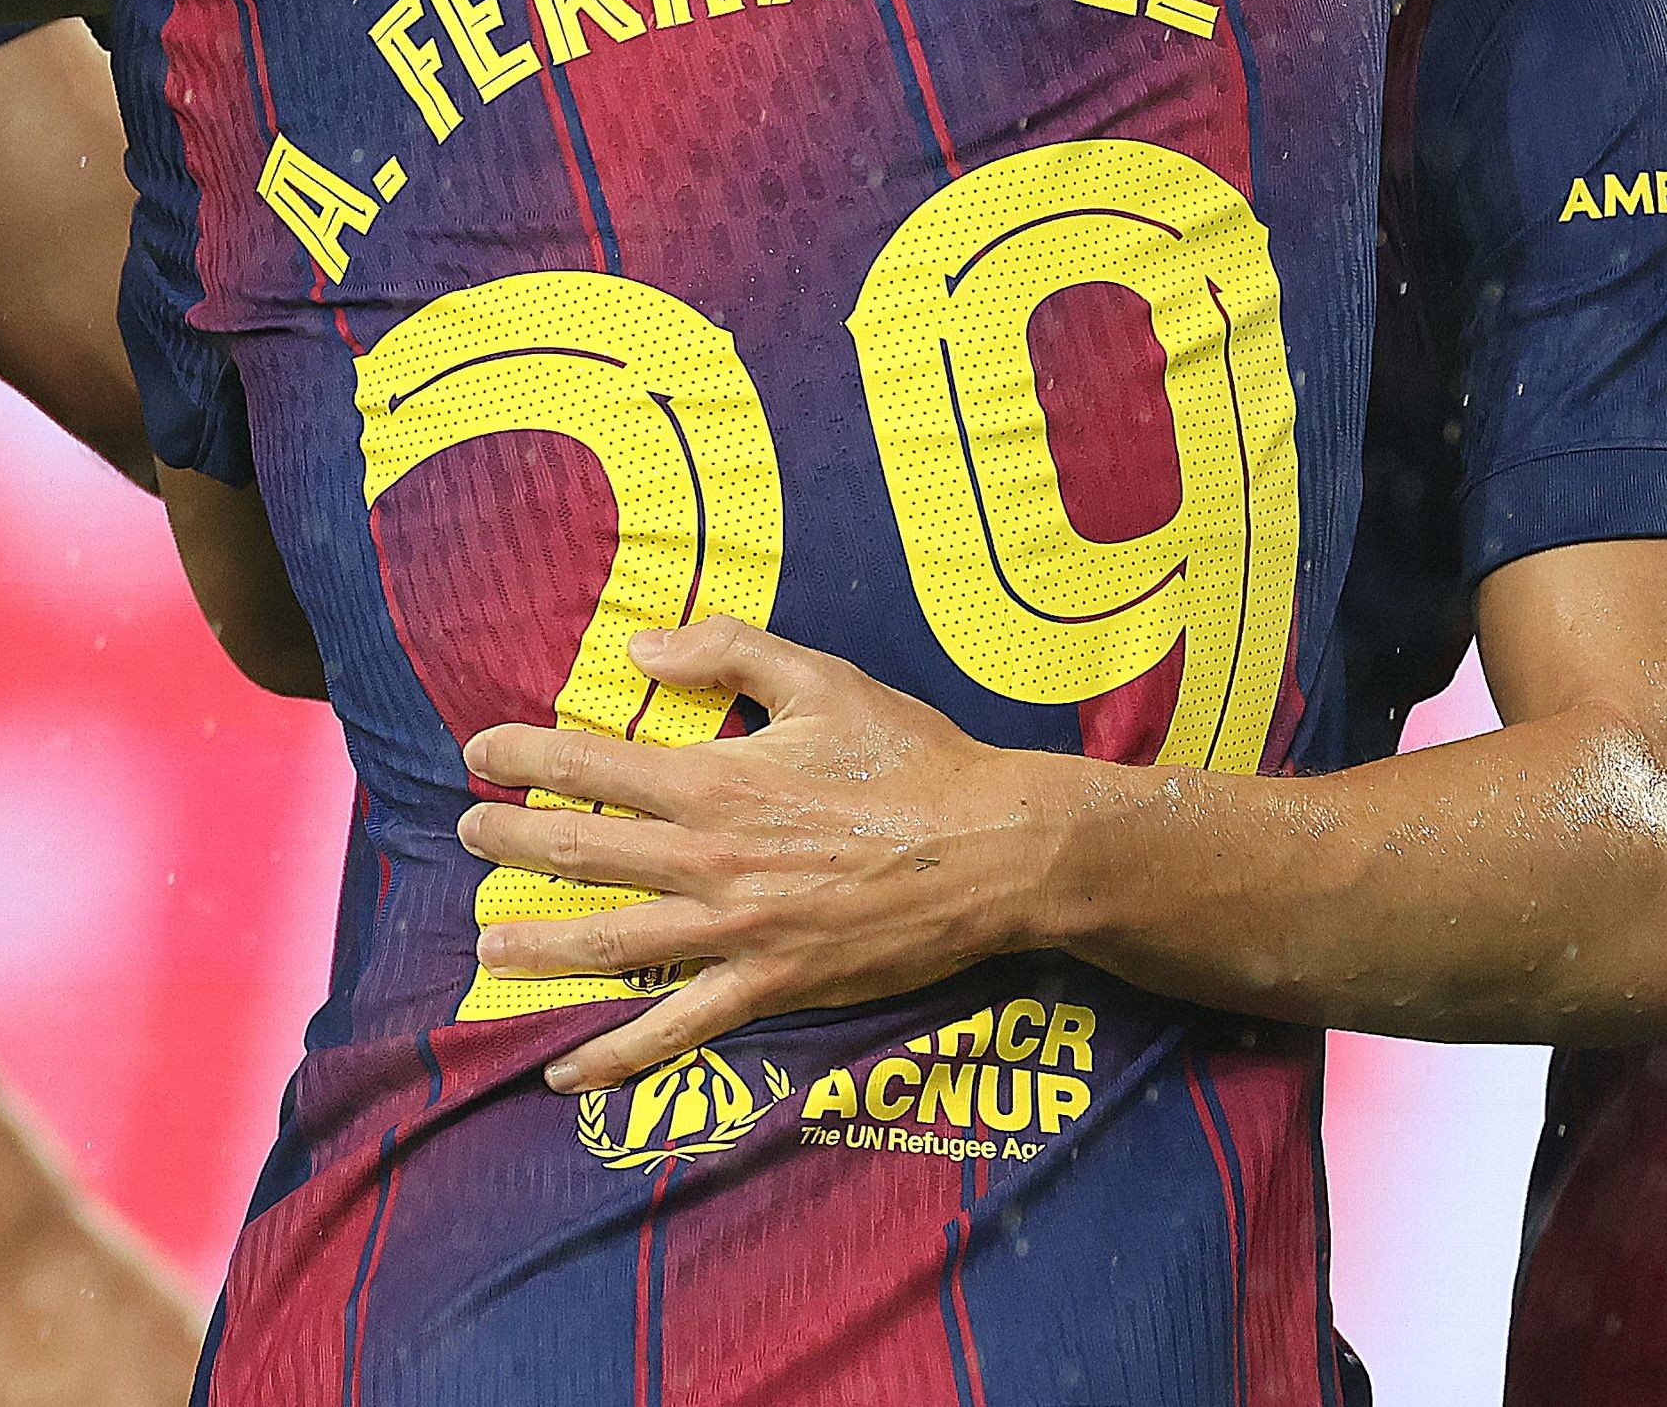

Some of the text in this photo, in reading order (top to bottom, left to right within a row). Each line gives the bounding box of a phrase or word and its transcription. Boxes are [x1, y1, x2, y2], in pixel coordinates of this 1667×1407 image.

[257, 131, 410, 285] A.
[354, 138, 1300, 1023] 29
[799, 1125, 841, 1146] The
[845, 1124, 884, 1151] UN
[888, 1127, 998, 1162] Refugee
